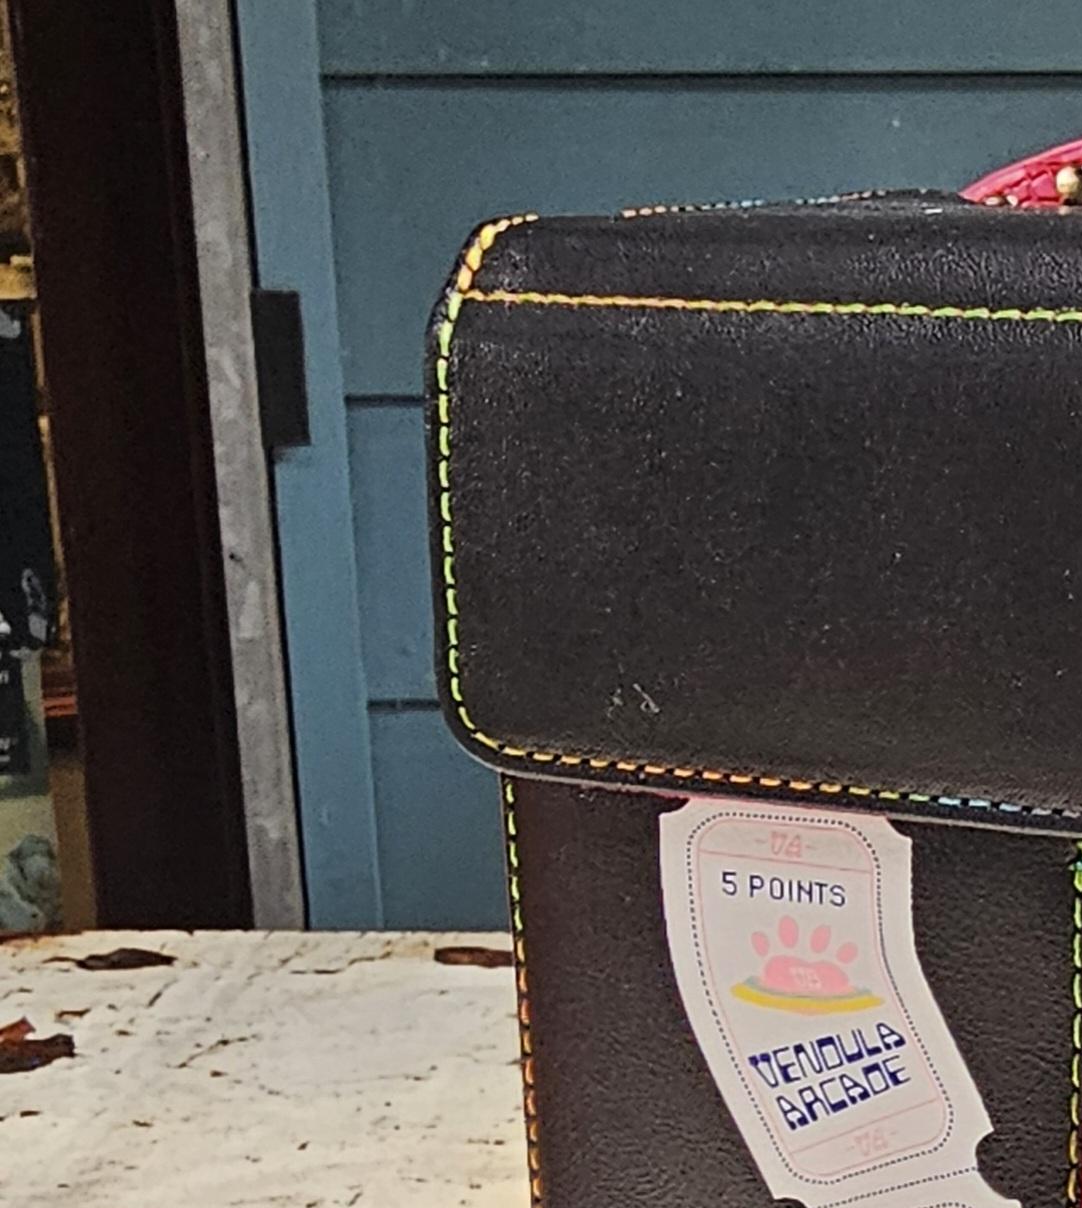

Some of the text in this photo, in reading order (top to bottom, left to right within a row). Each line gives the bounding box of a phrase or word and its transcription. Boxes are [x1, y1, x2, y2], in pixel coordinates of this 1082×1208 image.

[720, 871, 846, 907] 5 POINTS
[748, 1022, 907, 1088] VENDULA
[775, 1055, 911, 1130] ARCADE
